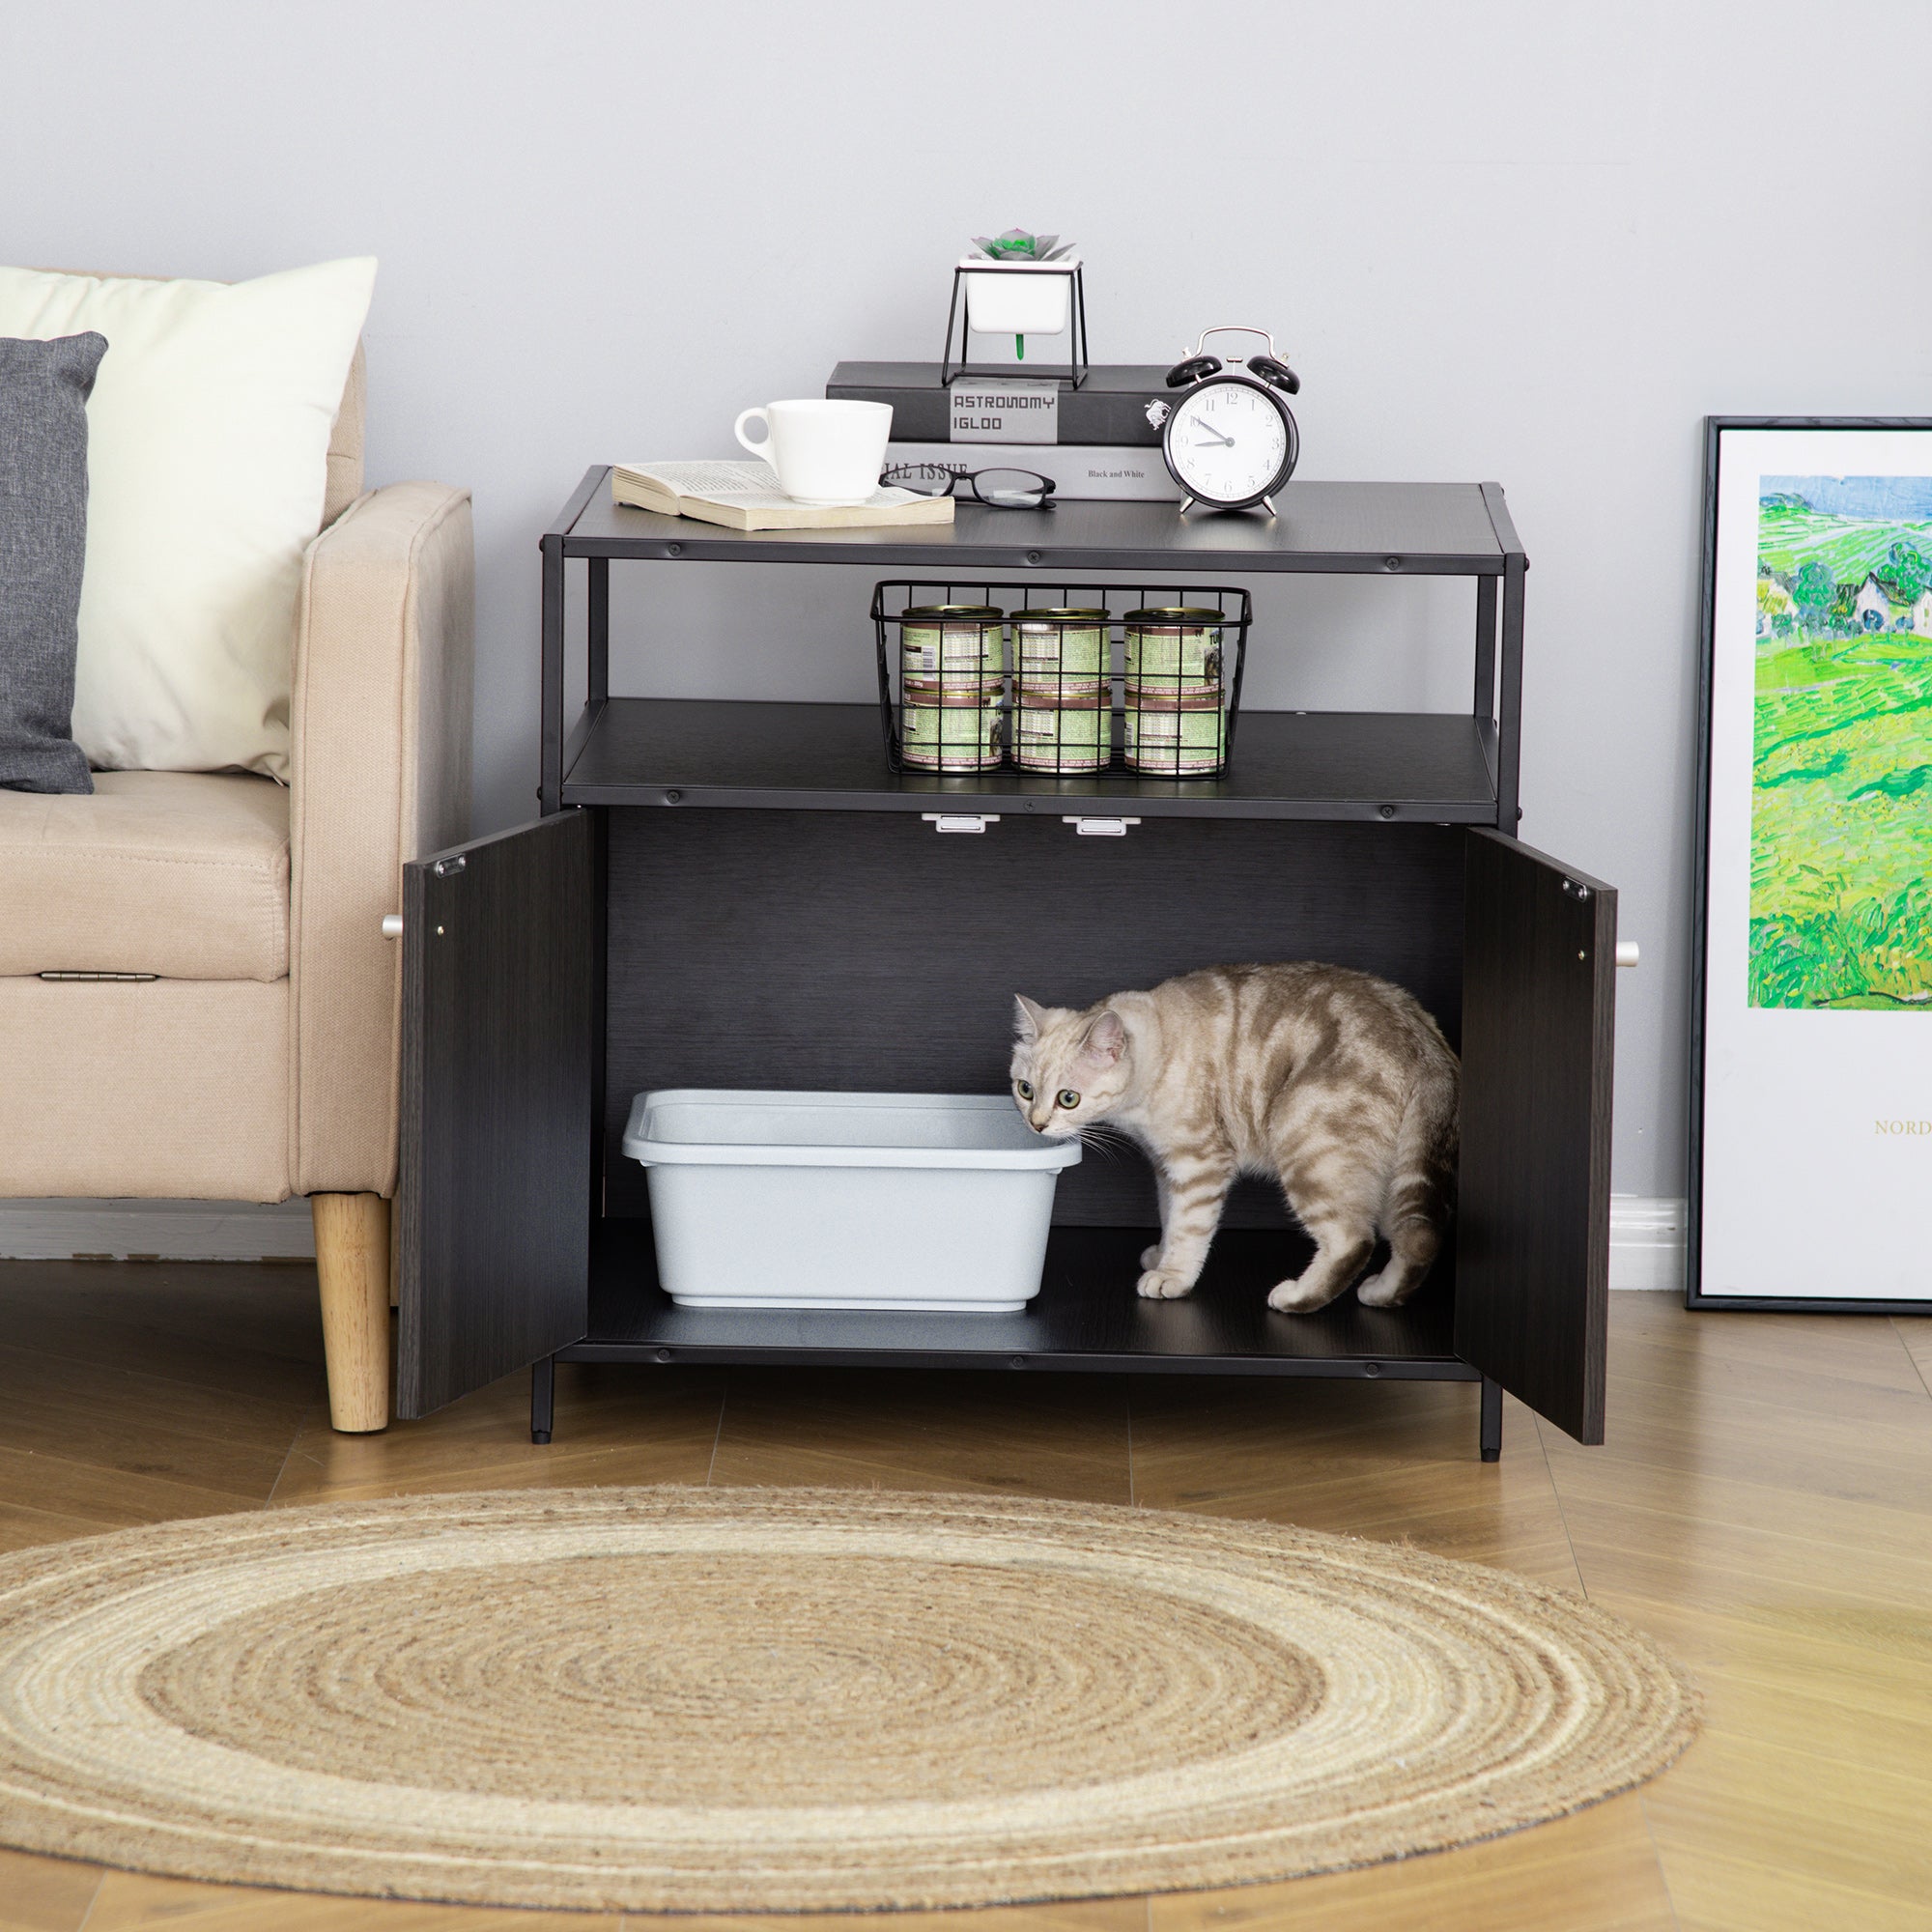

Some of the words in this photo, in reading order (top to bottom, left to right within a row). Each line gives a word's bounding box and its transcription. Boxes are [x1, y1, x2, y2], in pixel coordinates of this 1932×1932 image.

[953, 395, 1055, 410] ASTRONOMY
[1227, 392, 1238, 405] 12
[1206, 399, 1215, 412] 11
[953, 416, 1002, 430] IGLOO
[1265, 414, 1273, 427] 2
[1180, 436, 1189, 448] 9
[1271, 437, 1280, 450] 3
[1186, 458, 1195, 469] 8
[1263, 459, 1270, 470] 4
[1088, 469, 1108, 478] Black
[1109, 469, 1122, 478] and
[1123, 469, 1145, 478] White
[1205, 473, 1212, 485] 7
[1224, 480, 1233, 492] 6
[1247, 475, 1256, 488] 5
[1874, 1120, 1932, 1135] NORD
